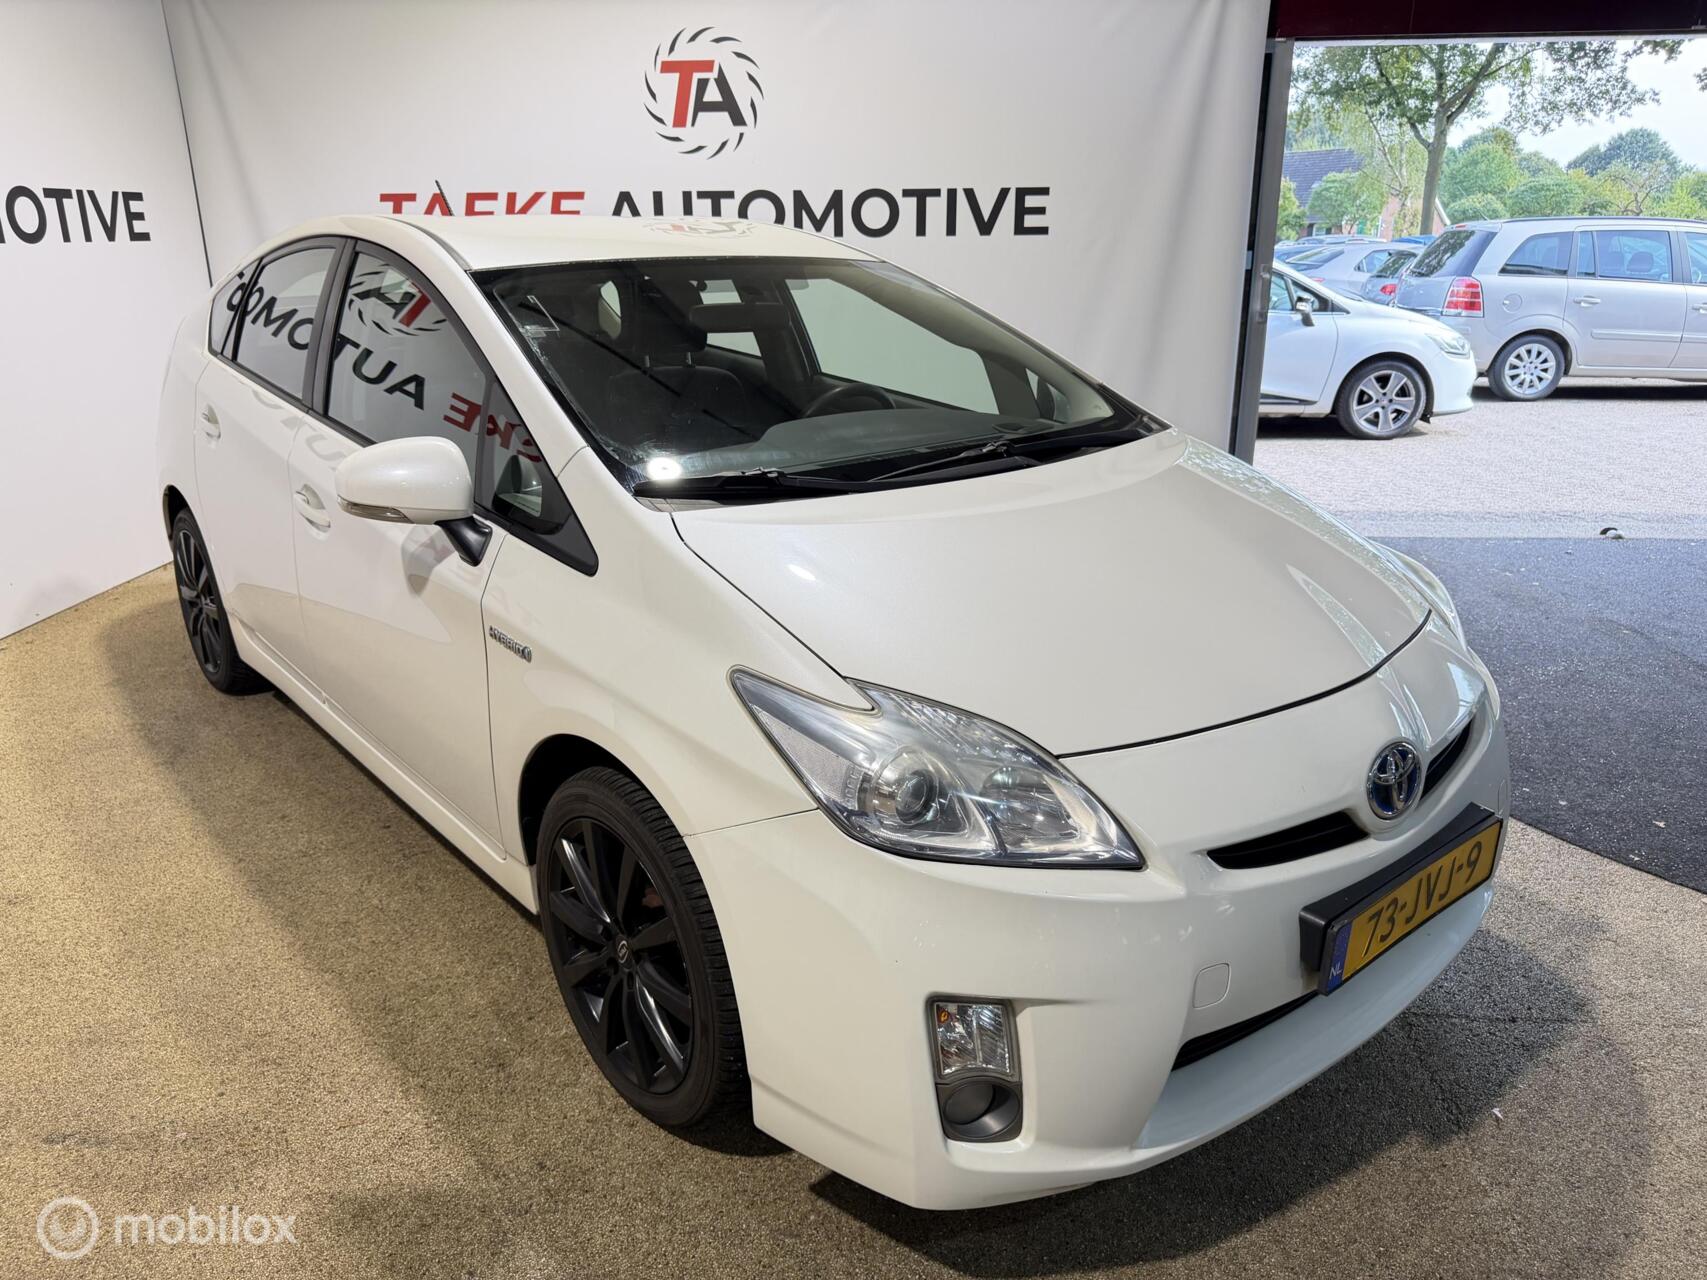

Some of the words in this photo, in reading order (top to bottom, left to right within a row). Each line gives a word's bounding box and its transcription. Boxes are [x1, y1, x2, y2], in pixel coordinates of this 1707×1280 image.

[660, 60, 748, 128] TA
[0, 185, 151, 244] OTIVE
[611, 187, 1051, 238] AUTOMOTIVE
[489, 625, 524, 660] HYBRID
[1361, 841, 1483, 960] 73-JVJ-9
